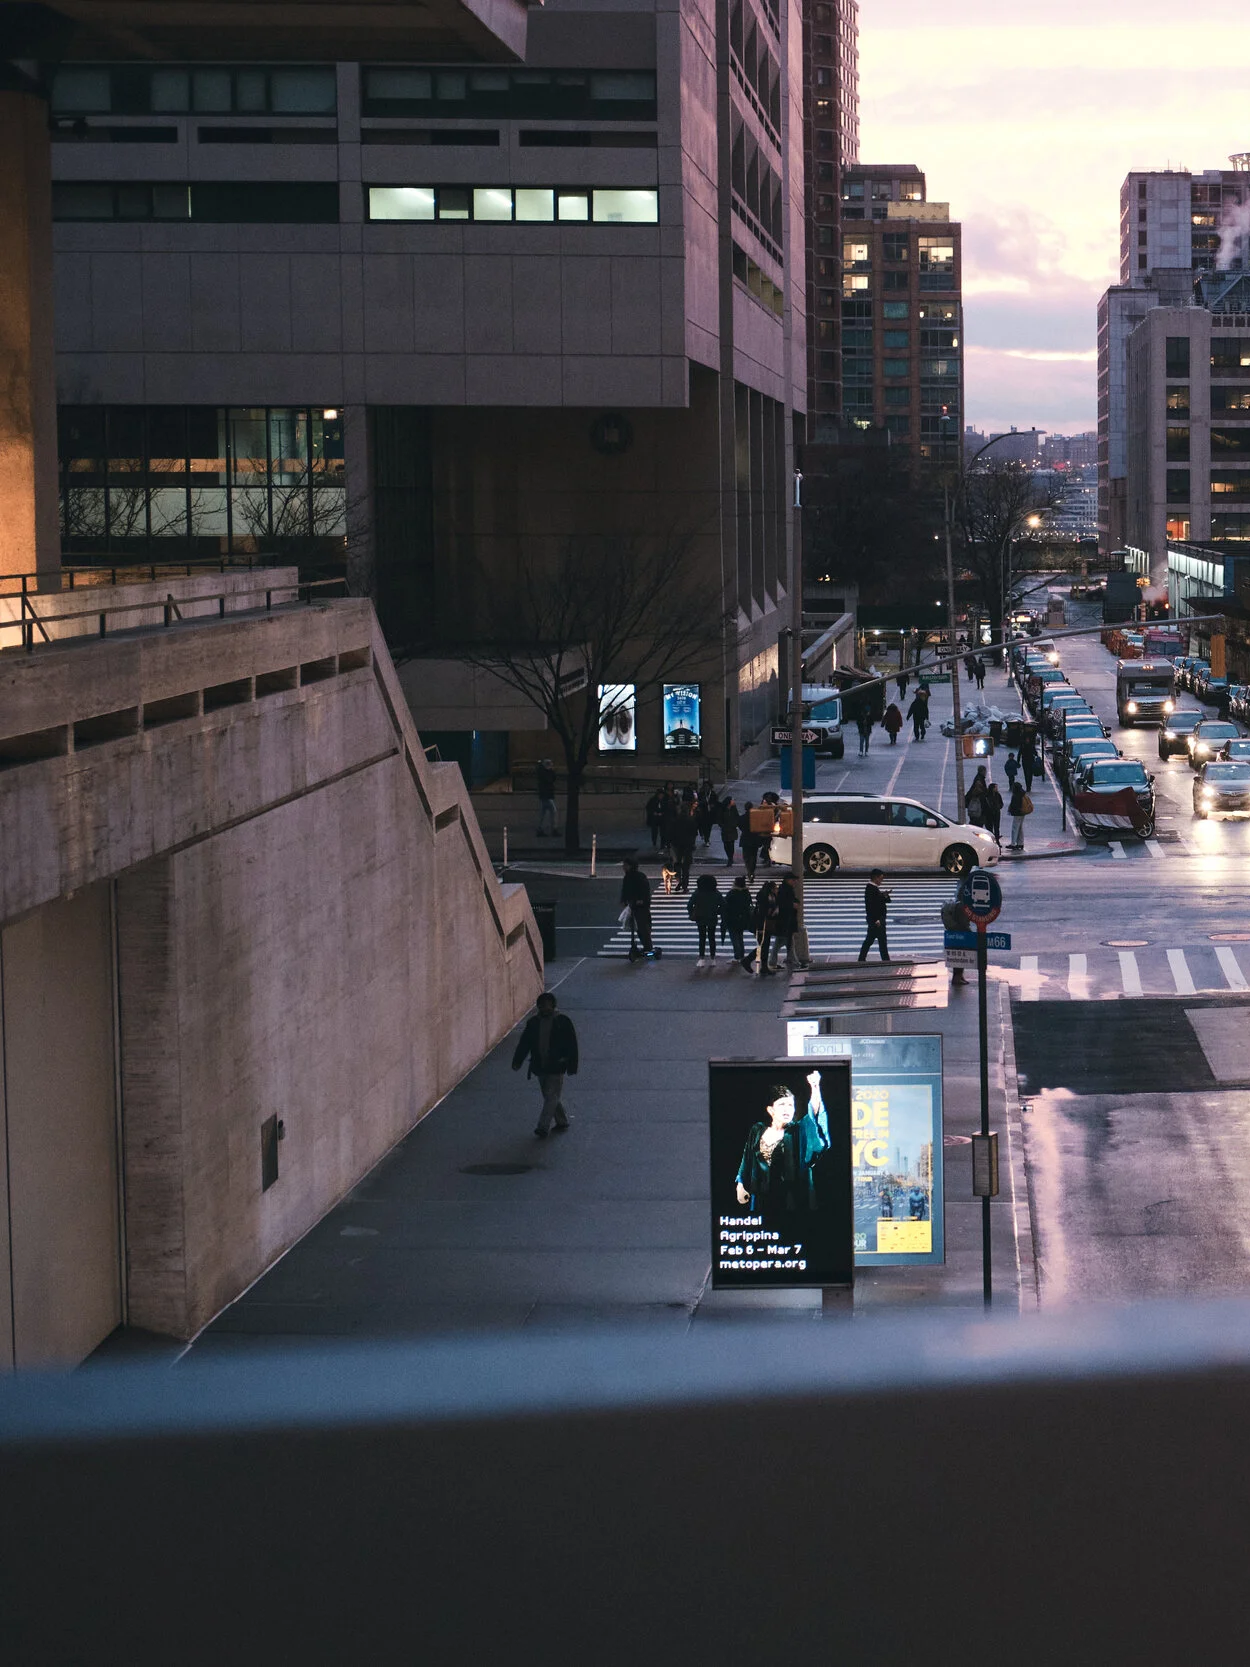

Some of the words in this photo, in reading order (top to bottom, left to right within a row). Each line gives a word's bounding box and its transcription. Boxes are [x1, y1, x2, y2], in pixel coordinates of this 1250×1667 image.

[778, 732, 792, 740] ONE
[720, 1216, 762, 1226] Handel
[720, 1231, 779, 1242] Agrippina
[720, 1245, 743, 1255] Feb
[745, 1245, 754, 1255] 6
[767, 1245, 791, 1254] Mar
[794, 1245, 802, 1254] 7
[720, 1260, 806, 1270] metopera.org
